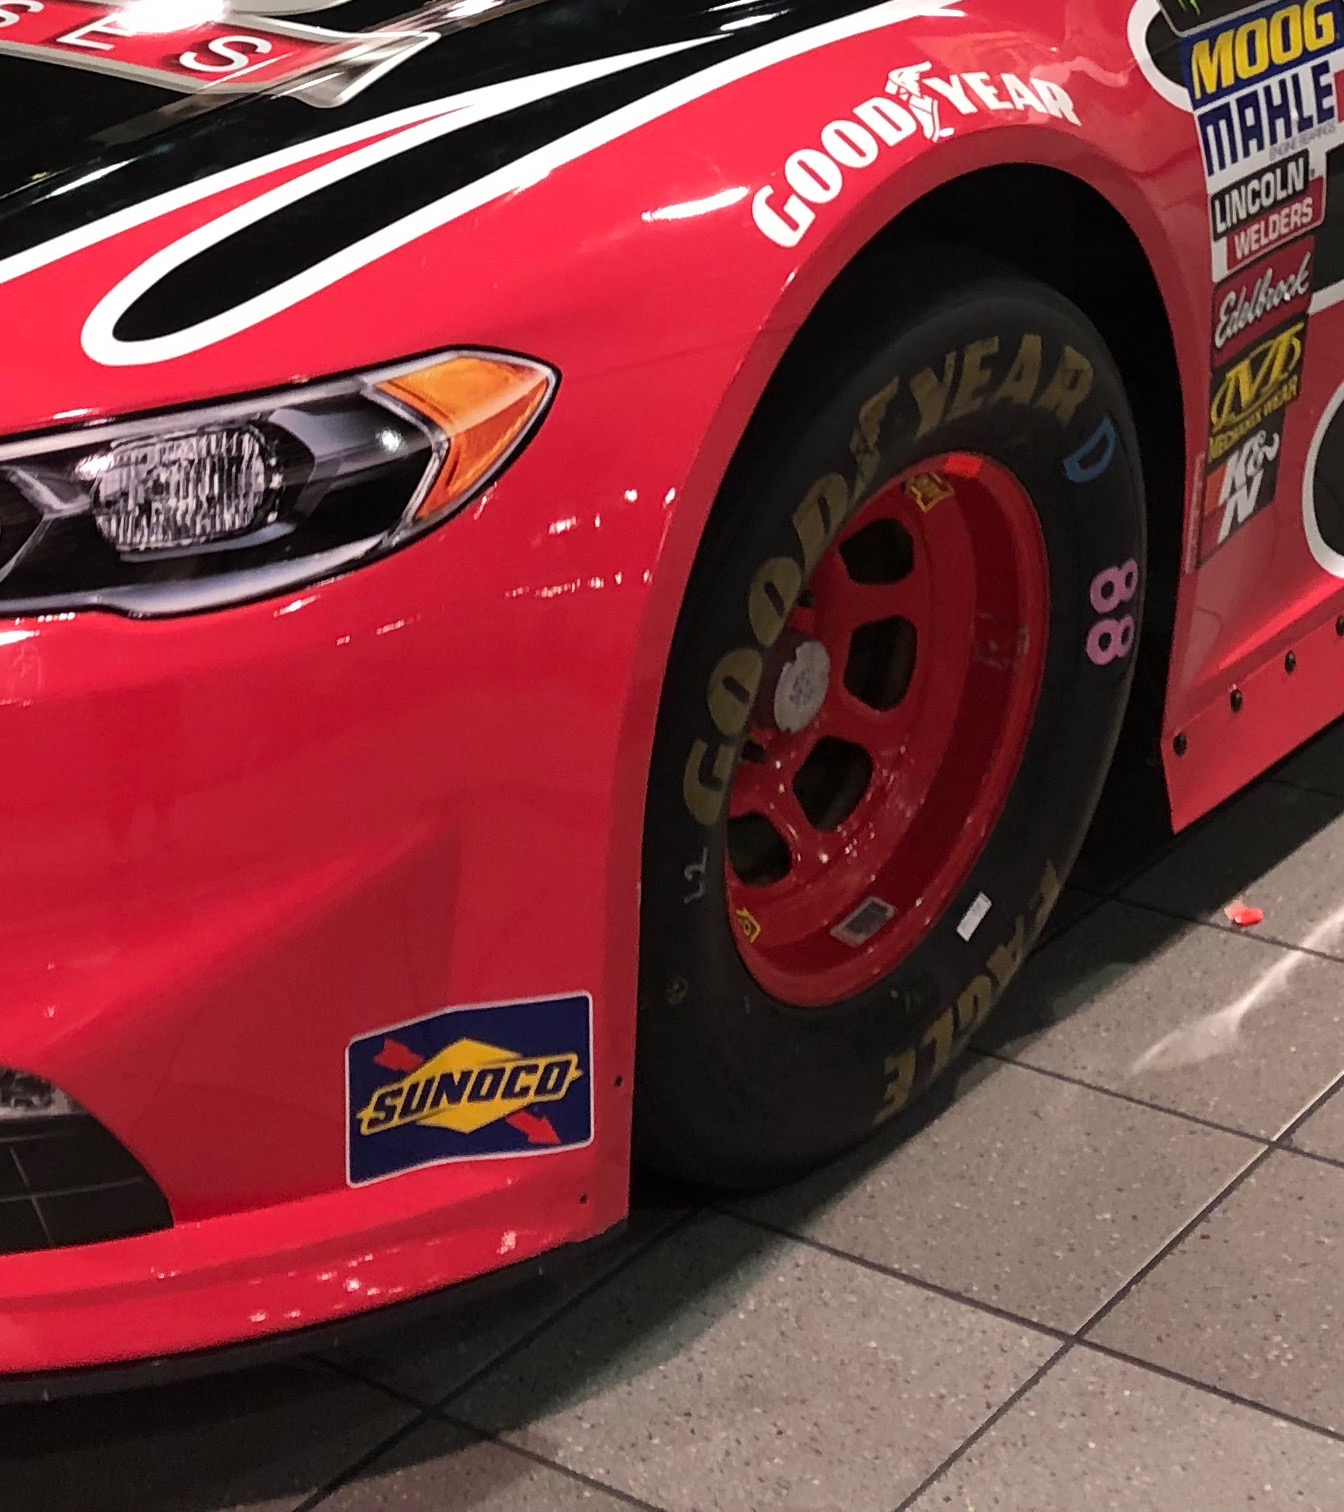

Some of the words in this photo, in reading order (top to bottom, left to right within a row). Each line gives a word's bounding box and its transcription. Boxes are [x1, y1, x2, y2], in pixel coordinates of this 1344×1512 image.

[1197, 60, 1336, 177] MAHLE
[1213, 156, 1306, 234] LINCOLN
[1233, 197, 1314, 260] WELDERS
[365, 1059, 573, 1130] SUNOCO
